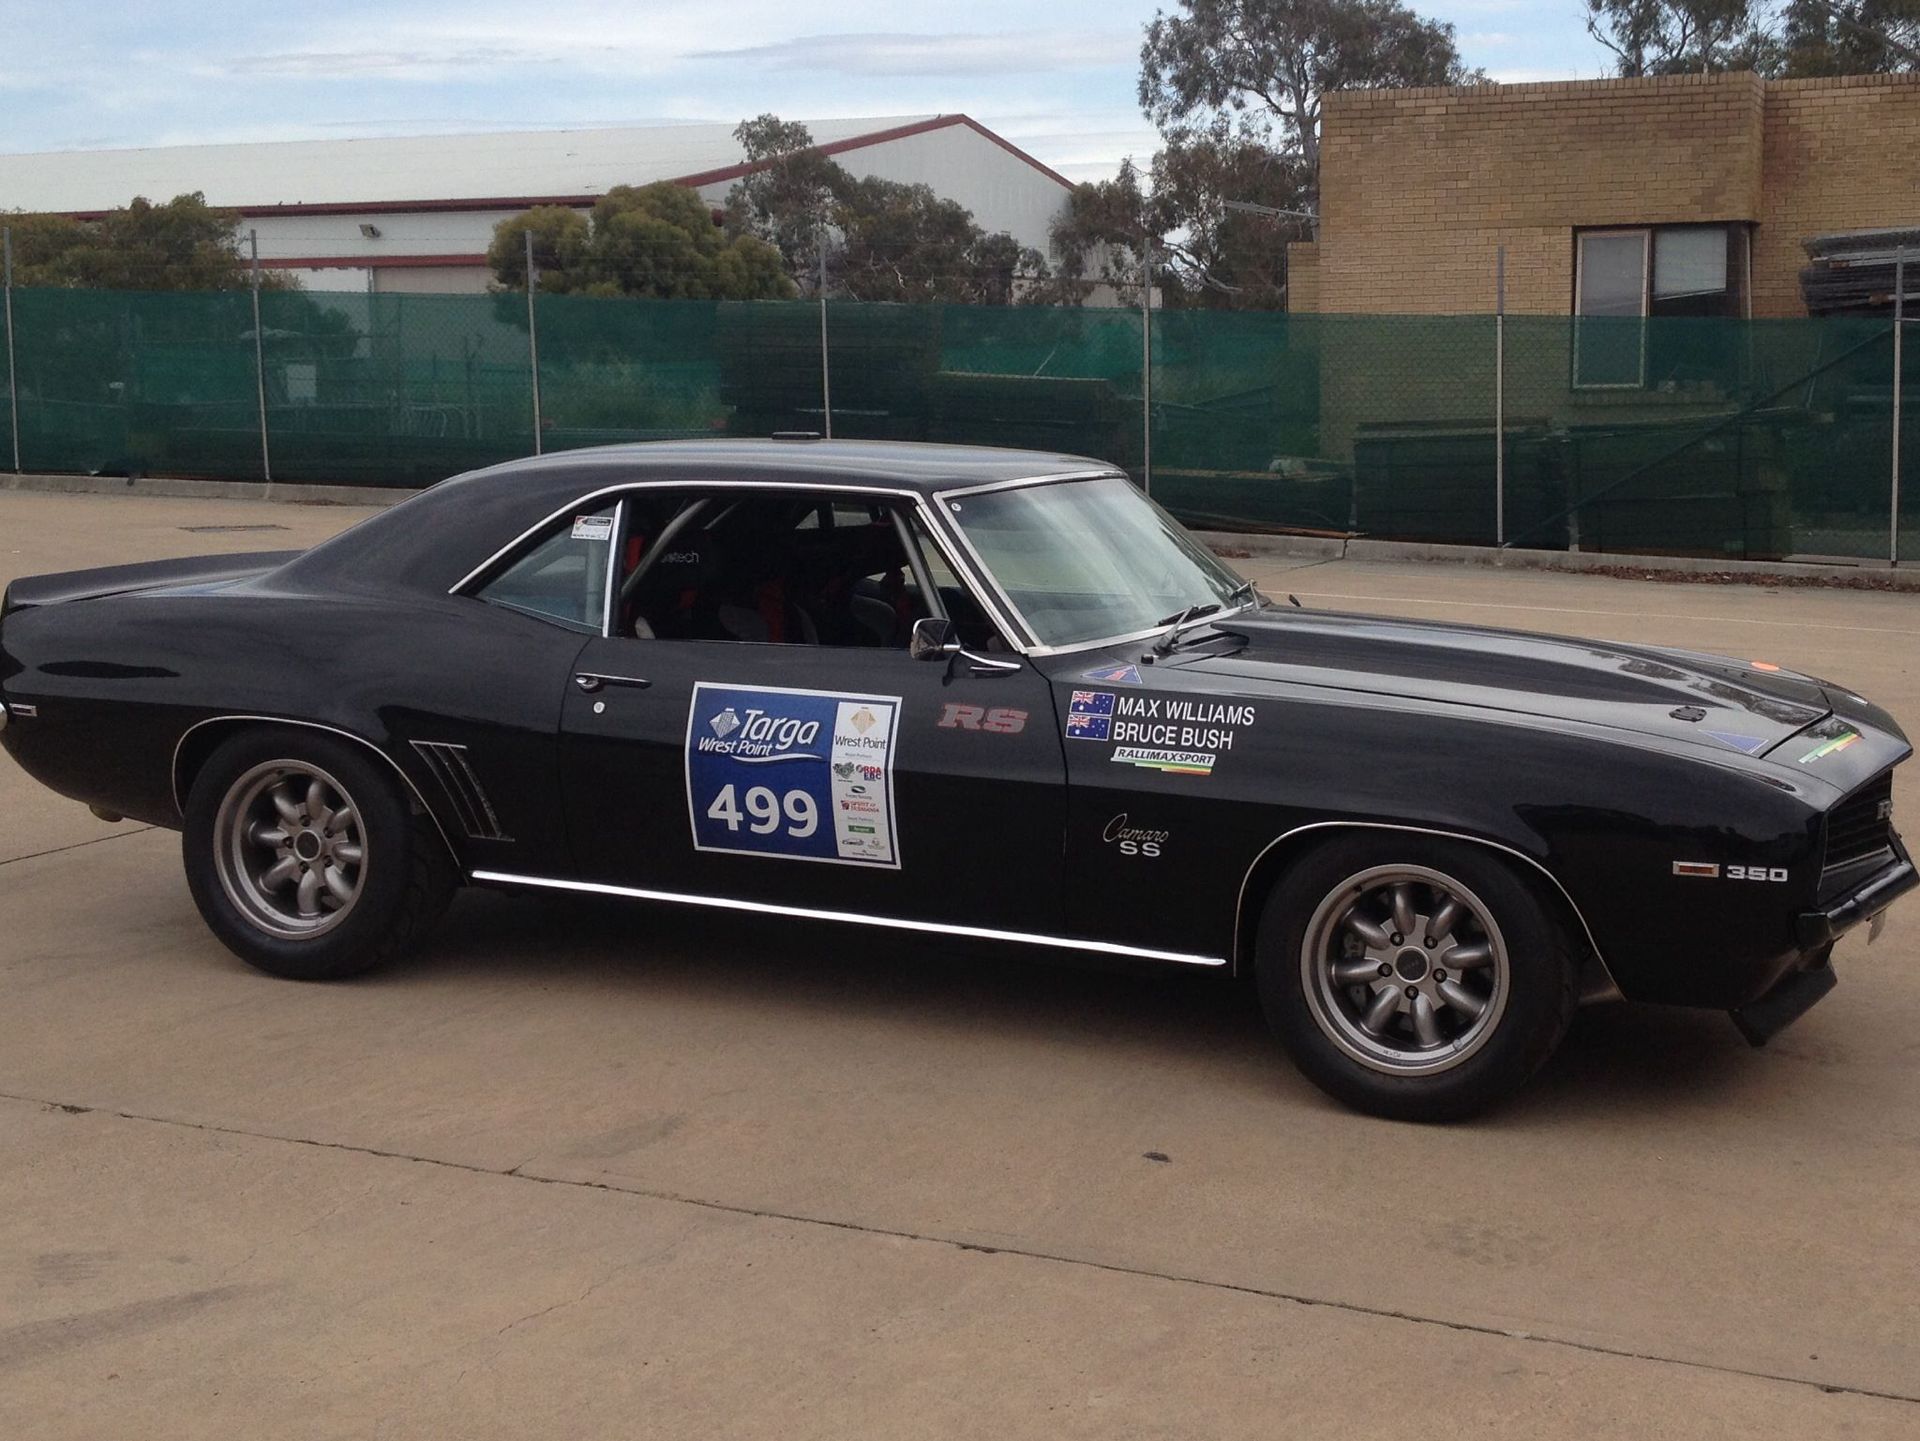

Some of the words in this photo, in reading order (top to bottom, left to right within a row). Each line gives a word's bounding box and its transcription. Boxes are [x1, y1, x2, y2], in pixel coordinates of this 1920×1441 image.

[937, 703, 1029, 733] RS
[1117, 697, 1161, 718] MAX
[1166, 700, 1256, 726] WILLIAMS
[740, 709, 820, 750] Targa
[835, 735, 861, 748] Wrest
[862, 736, 887, 749] Point
[1113, 721, 1178, 745] BRUCE
[1181, 727, 1234, 750] BUSH
[698, 736, 737, 754] Wrest
[737, 740, 772, 756] Point
[1117, 748, 1215, 764] RALLIMAXSPORT
[707, 784, 818, 837] 499
[1103, 813, 1169, 842] Camaro
[1120, 840, 1161, 857] SS
[1726, 864, 1789, 882] 350
